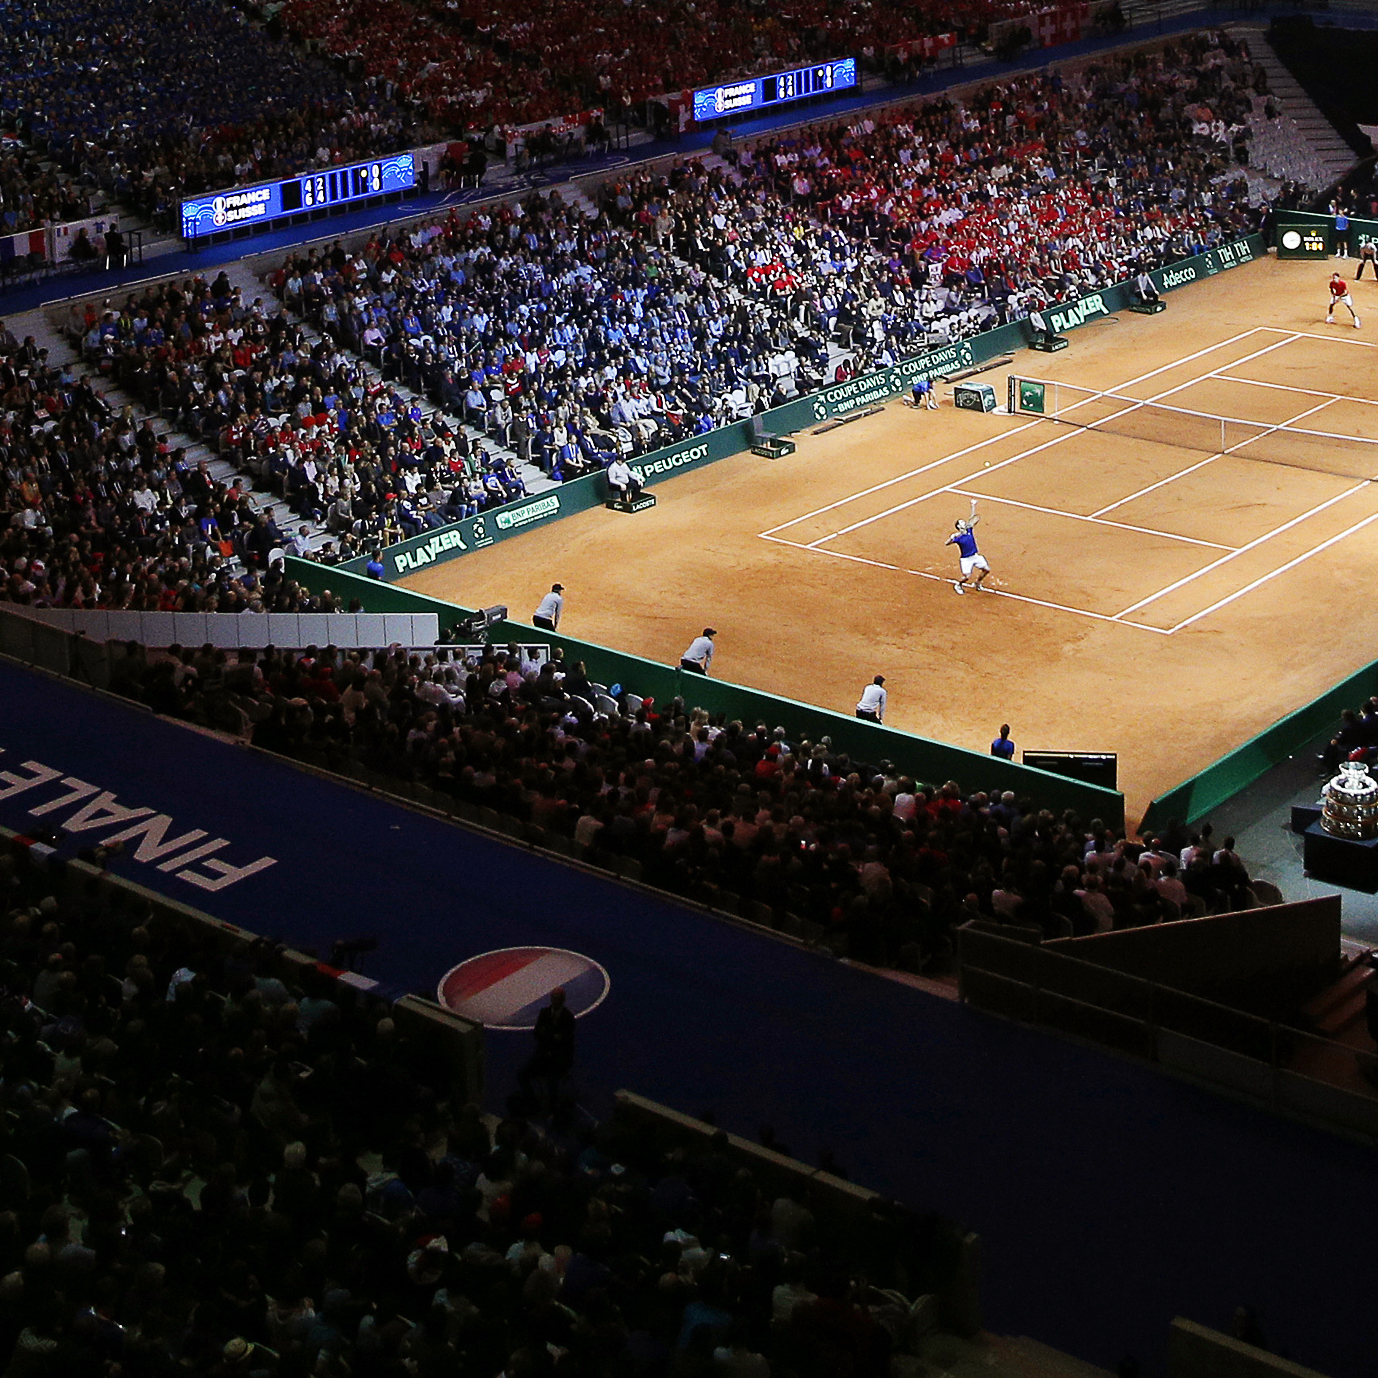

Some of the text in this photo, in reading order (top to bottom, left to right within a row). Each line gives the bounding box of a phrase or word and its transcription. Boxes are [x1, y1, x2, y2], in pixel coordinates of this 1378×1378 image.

[724, 82, 756, 99] FRANCE
[778, 76, 785, 87] 4
[786, 75, 793, 85] 2
[724, 95, 752, 109] SUISSE
[779, 87, 785, 98] 6
[787, 85, 793, 96] 4
[226, 188, 271, 209] FRANCE
[304, 179, 312, 193] 4
[316, 177, 323, 190] 2
[226, 203, 266, 222] SUISSE
[305, 193, 313, 206] 6
[317, 190, 325, 203] 4
[1162, 266, 1196, 288] Adecco
[1050, 293, 1110, 333] PLAYZER
[901, 347, 958, 376] COUPE DAVIS
[929, 360, 961, 381] PARIBAS
[826, 373, 886, 403] COUPE DAVIS
[856, 386, 890, 408] PARIBAS
[644, 443, 710, 478] PEUGEOT
[511, 508, 526, 522] BNP
[525, 498, 556, 517] PARIBAS
[632, 497, 656, 512] LACOSTE
[394, 529, 468, 573] PLAYZER
